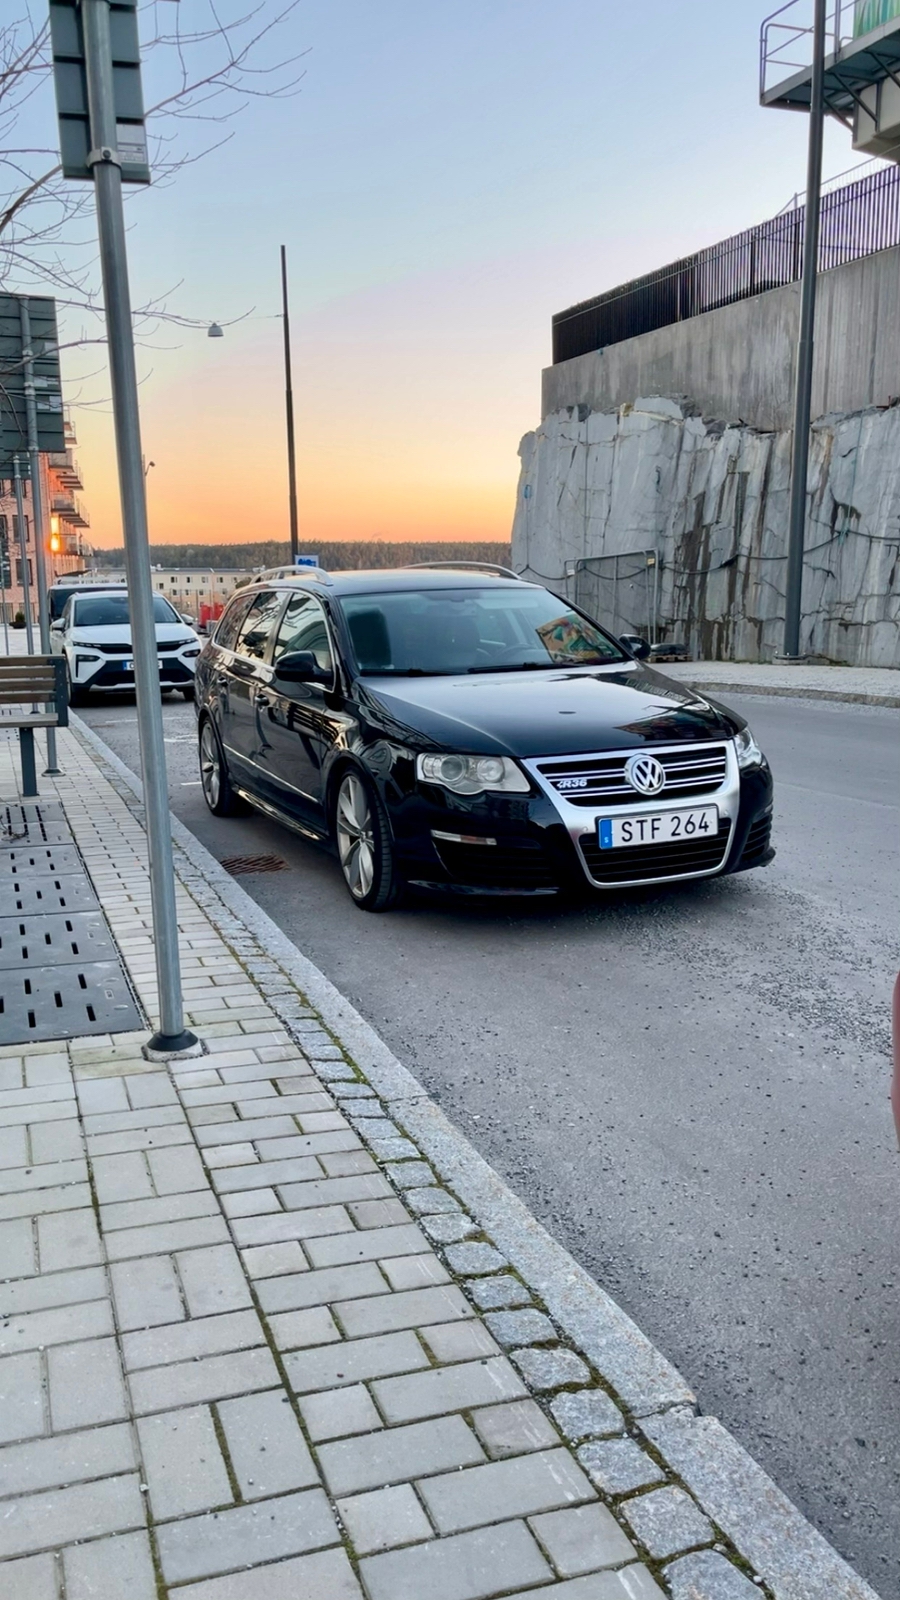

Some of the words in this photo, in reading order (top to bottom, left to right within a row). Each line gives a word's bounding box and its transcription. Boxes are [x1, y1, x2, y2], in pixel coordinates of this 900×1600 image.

[560, 778, 587, 789] R36
[633, 758, 663, 792] VW
[621, 817, 662, 843] STF
[670, 812, 709, 837] 264
